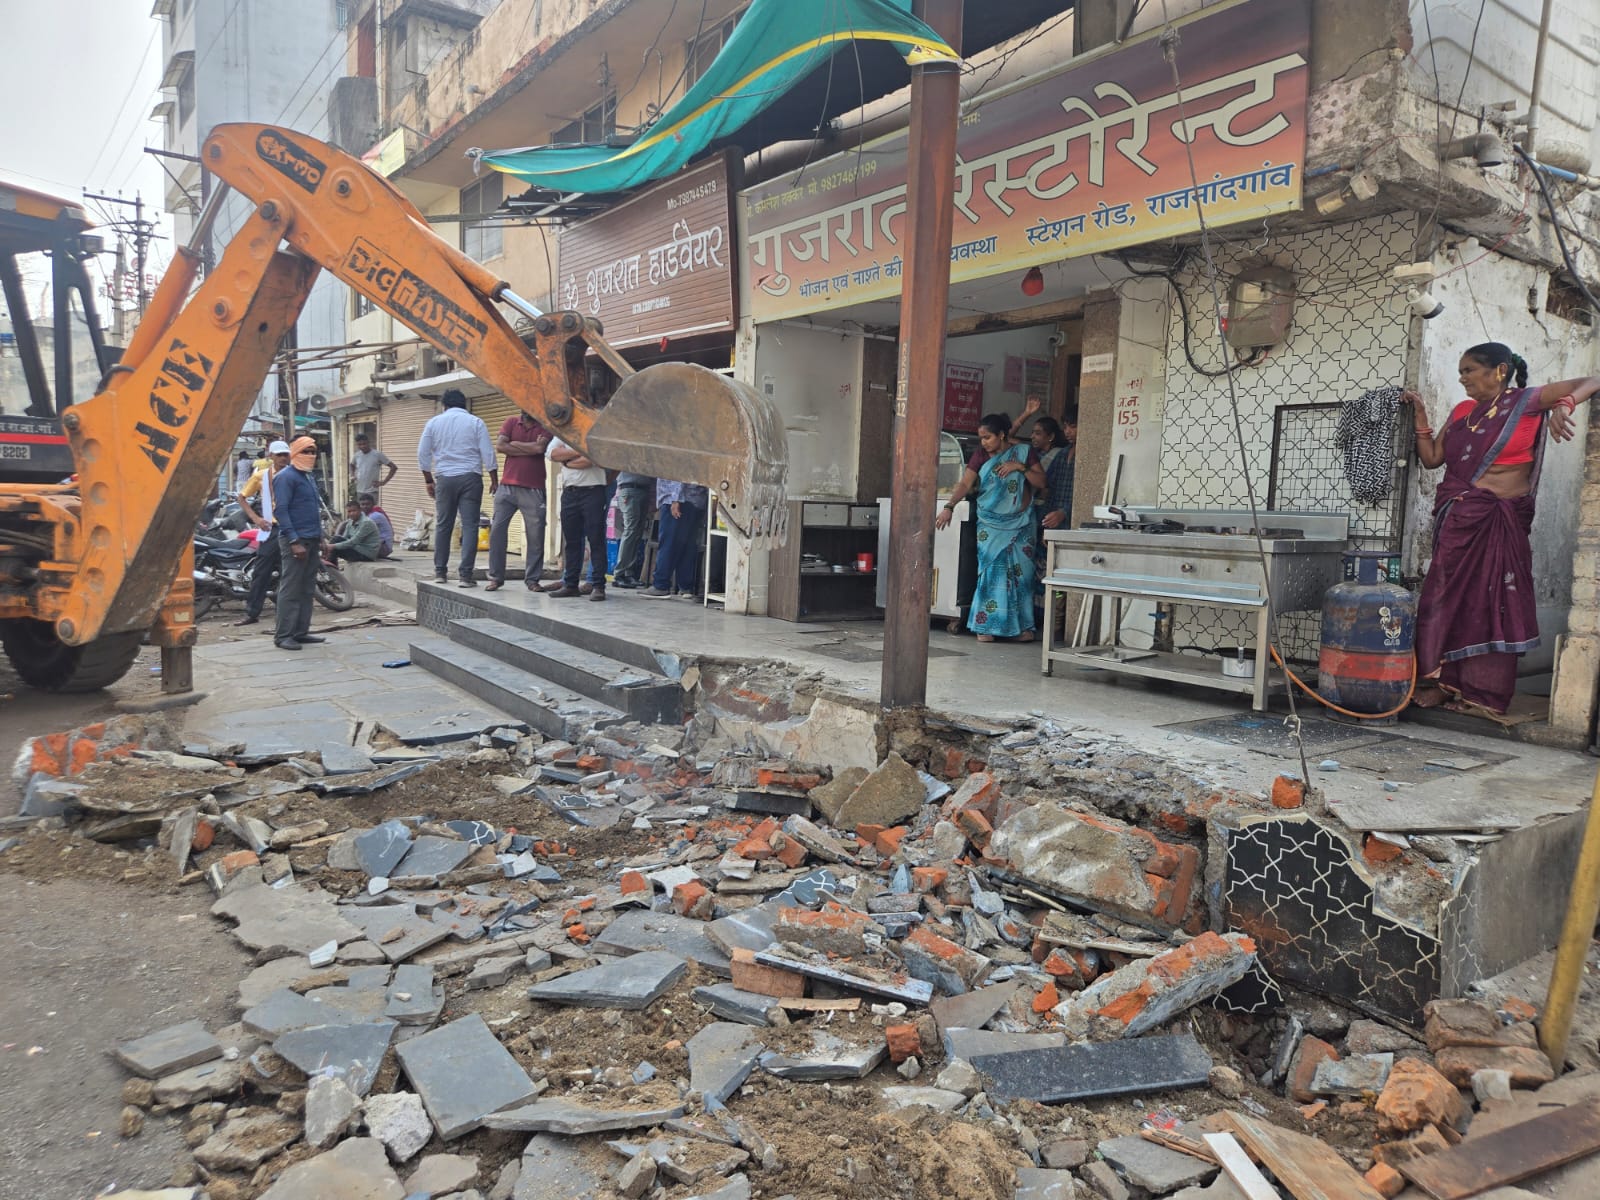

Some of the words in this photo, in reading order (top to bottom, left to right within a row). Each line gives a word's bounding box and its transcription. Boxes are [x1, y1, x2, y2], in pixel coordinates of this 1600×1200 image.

[1026, 216, 1086, 247] स्टेशन
[1146, 161, 1296, 217] राजनांदगांव
[586, 254, 642, 315] गुजरात
[648, 218, 724, 285] हार्डवेयर
[799, 279, 830, 298] भोजन
[1118, 410, 1140, 425] 155
